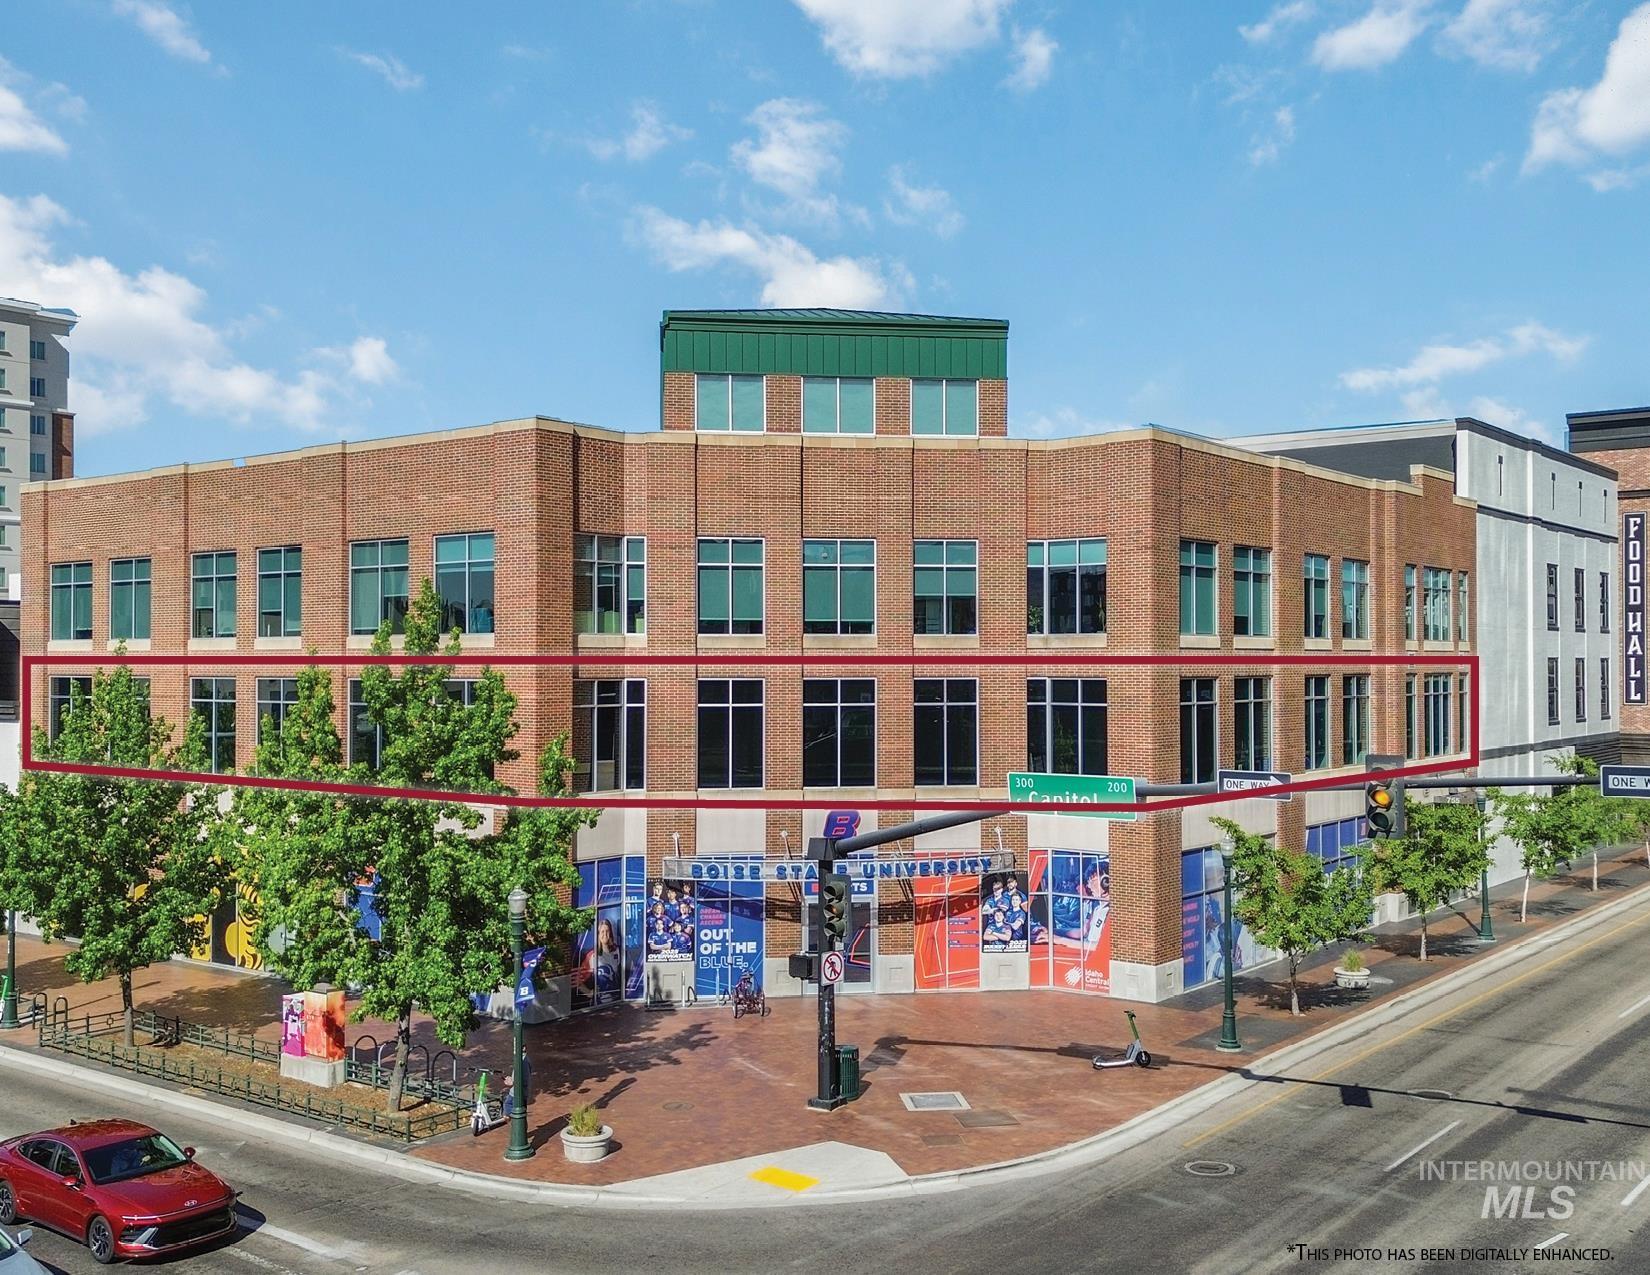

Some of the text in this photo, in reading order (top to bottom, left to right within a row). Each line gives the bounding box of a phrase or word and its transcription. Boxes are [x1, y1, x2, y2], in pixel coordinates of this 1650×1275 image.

[1627, 517, 1643, 700] FOOD HALL
[1015, 778, 1034, 788] 300
[1107, 782, 1127, 792] 200
[1226, 780, 1245, 789] ONE
[1611, 776, 1636, 788] ONE
[1028, 791, 1098, 807] Capitol
[691, 856, 991, 880] BOISE STAE UNIVERSITY
[700, 928, 733, 940] OUT
[700, 941, 757, 955] OF THE
[699, 955, 749, 969] BLUE.
